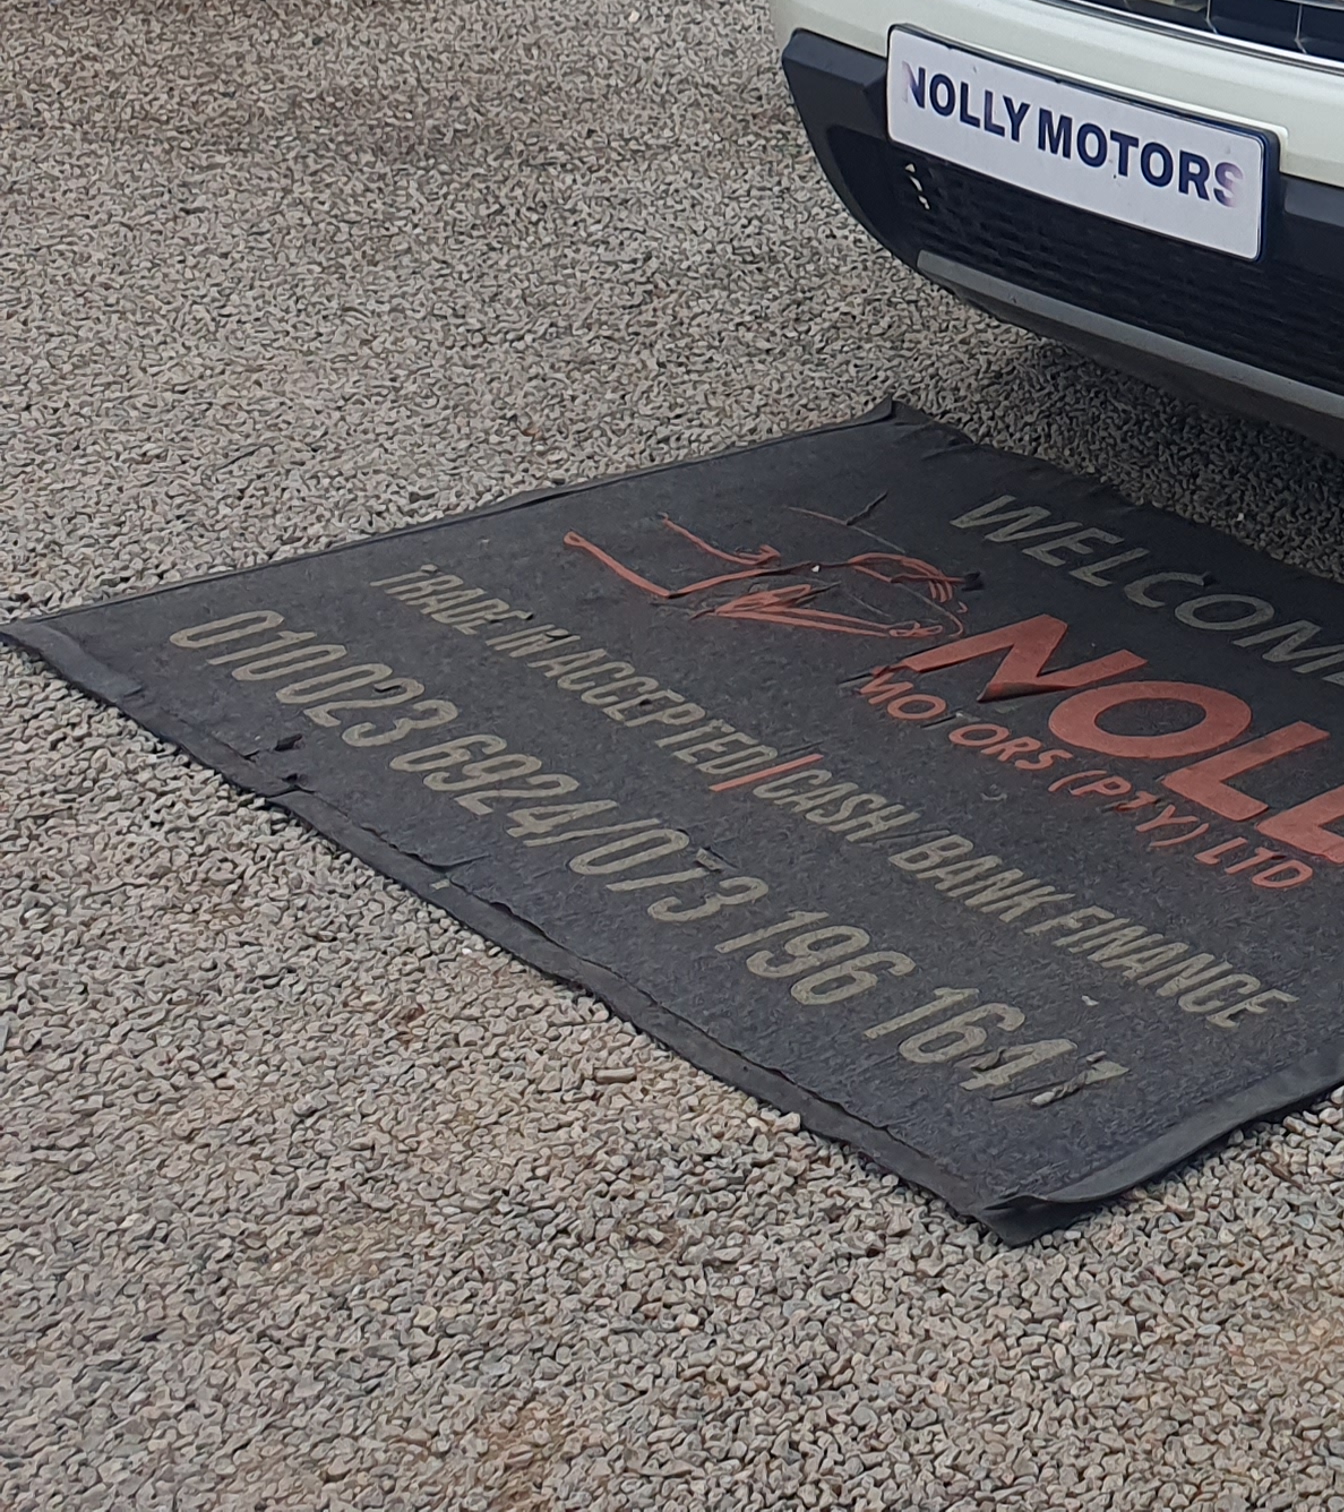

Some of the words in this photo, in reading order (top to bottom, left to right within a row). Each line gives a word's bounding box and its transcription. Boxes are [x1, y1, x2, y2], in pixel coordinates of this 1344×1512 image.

[901, 60, 1031, 143] NOLLY
[1037, 106, 1245, 209] MOTORS
[370, 564, 533, 636] TRADE
[485, 623, 582, 658] IN
[1023, 904, 1300, 1029] FINANCE
[860, 671, 1074, 771] MOORS
[1194, 836, 1314, 888] LTD
[714, 910, 917, 1005] 196
